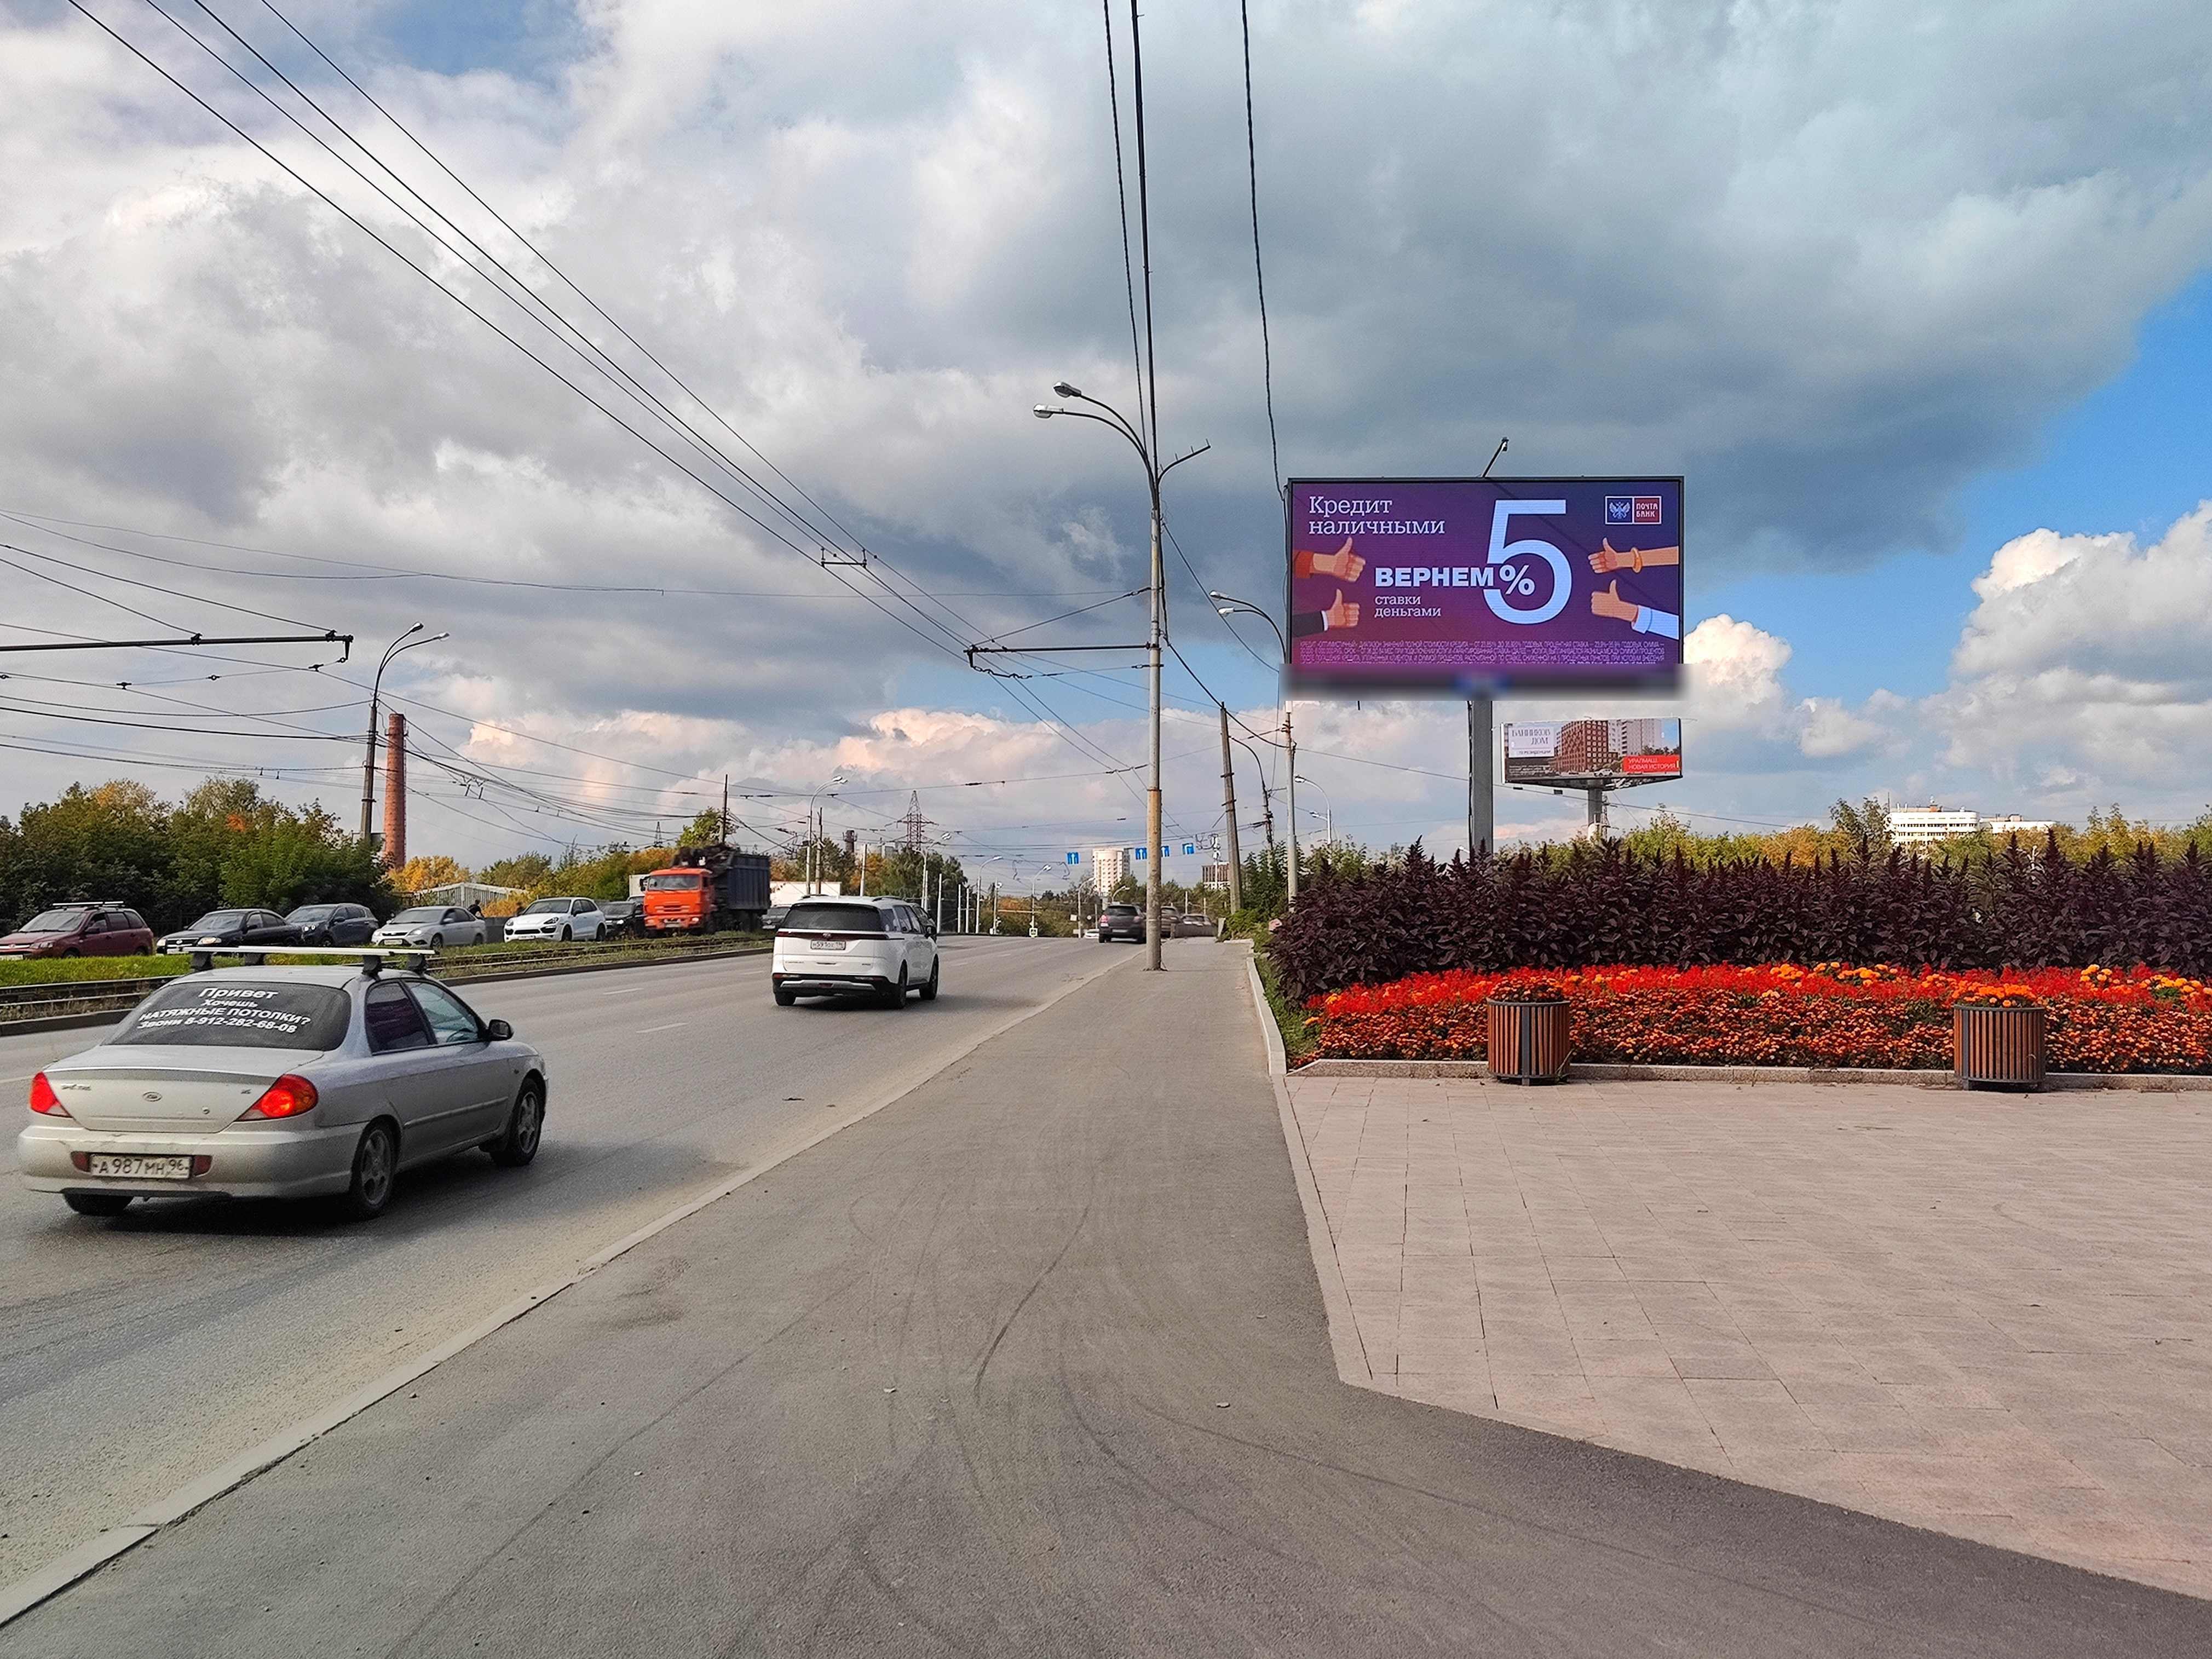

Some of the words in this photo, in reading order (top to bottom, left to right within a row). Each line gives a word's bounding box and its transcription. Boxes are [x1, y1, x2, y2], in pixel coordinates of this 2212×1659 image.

[1309, 496, 1392, 517] Кредит
[1309, 521, 1445, 535] наличными
[1374, 596, 1421, 605] ставки
[1374, 608, 1442, 618] деньгами
[1531, 736, 1548, 745] ДОМ
[198, 987, 278, 999] Привет
[201, 999, 258, 1008] Хочешь
[139, 1007, 226, 1021] НАТЯЖНЫЕ
[227, 1008, 311, 1025] ПОТОЛКИ?
[137, 1018, 182, 1029] Звони
[184, 1017, 298, 1033] 8-912-282-68-08
